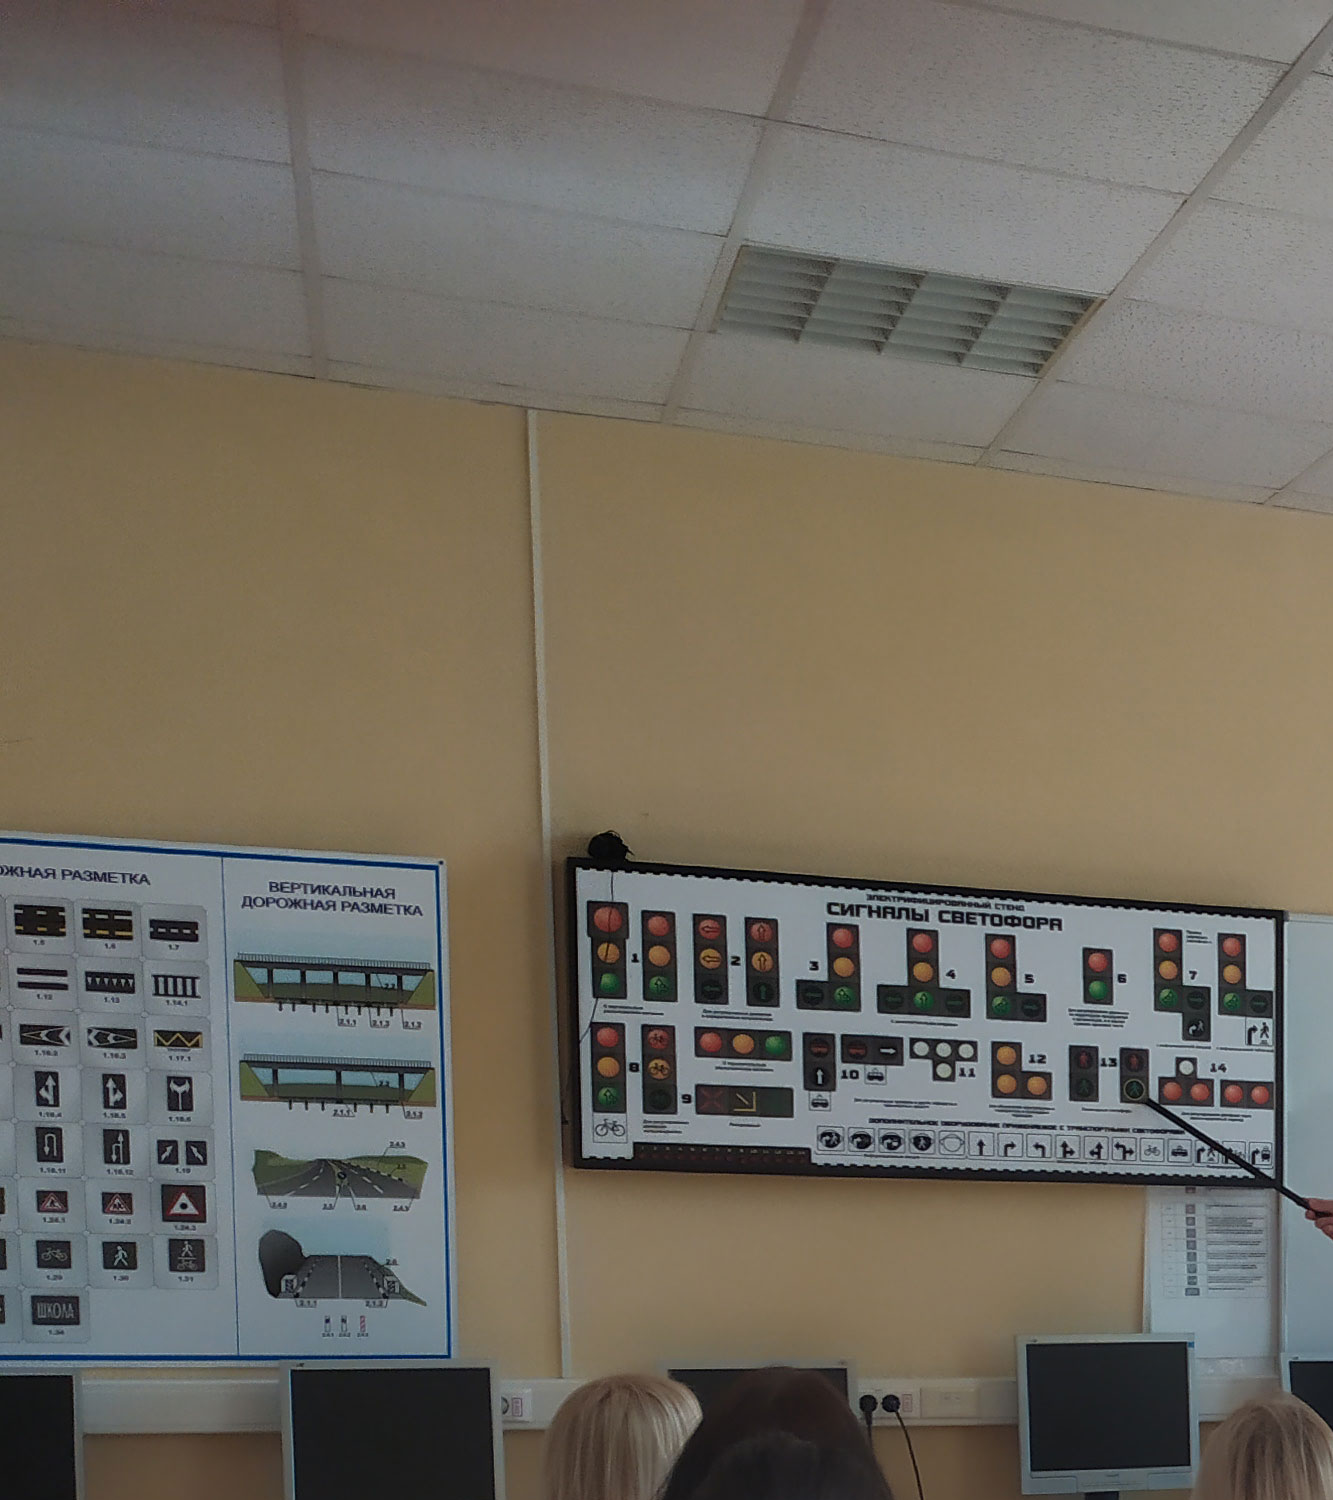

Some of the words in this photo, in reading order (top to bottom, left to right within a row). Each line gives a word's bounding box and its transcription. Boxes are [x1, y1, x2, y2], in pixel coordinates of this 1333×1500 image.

[61, 868, 151, 886] РАЗМЕТКА
[268, 881, 396, 900] ВЕРТИКАЛЬНАЯ
[241, 896, 336, 911] ДОРОЖНАЯ
[341, 900, 423, 917] РАЗМЕТКА
[826, 901, 930, 923] СИГНАЛЫ
[938, 910, 1063, 932] СВЕТОФОРА
[631, 953, 639, 963] 1
[730, 956, 741, 966] 2
[809, 961, 819, 971] 3
[946, 969, 956, 979] 4
[1024, 974, 1034, 984] 5
[1117, 973, 1127, 984] 6
[1189, 970, 1197, 980] 7
[339, 1018, 357, 1026] 2.1.1
[1028, 1054, 1046, 1064] 12
[1100, 1058, 1117, 1067] 13
[629, 1062, 639, 1072] 8
[1210, 1063, 1227, 1073] 14
[841, 1069, 859, 1079] 10
[958, 1068, 976, 1078] 11
[681, 1094, 692, 1104] 9
[332, 1109, 350, 1117] 2.1.1
[37, 1302, 74, 1319] ШКОЛА
